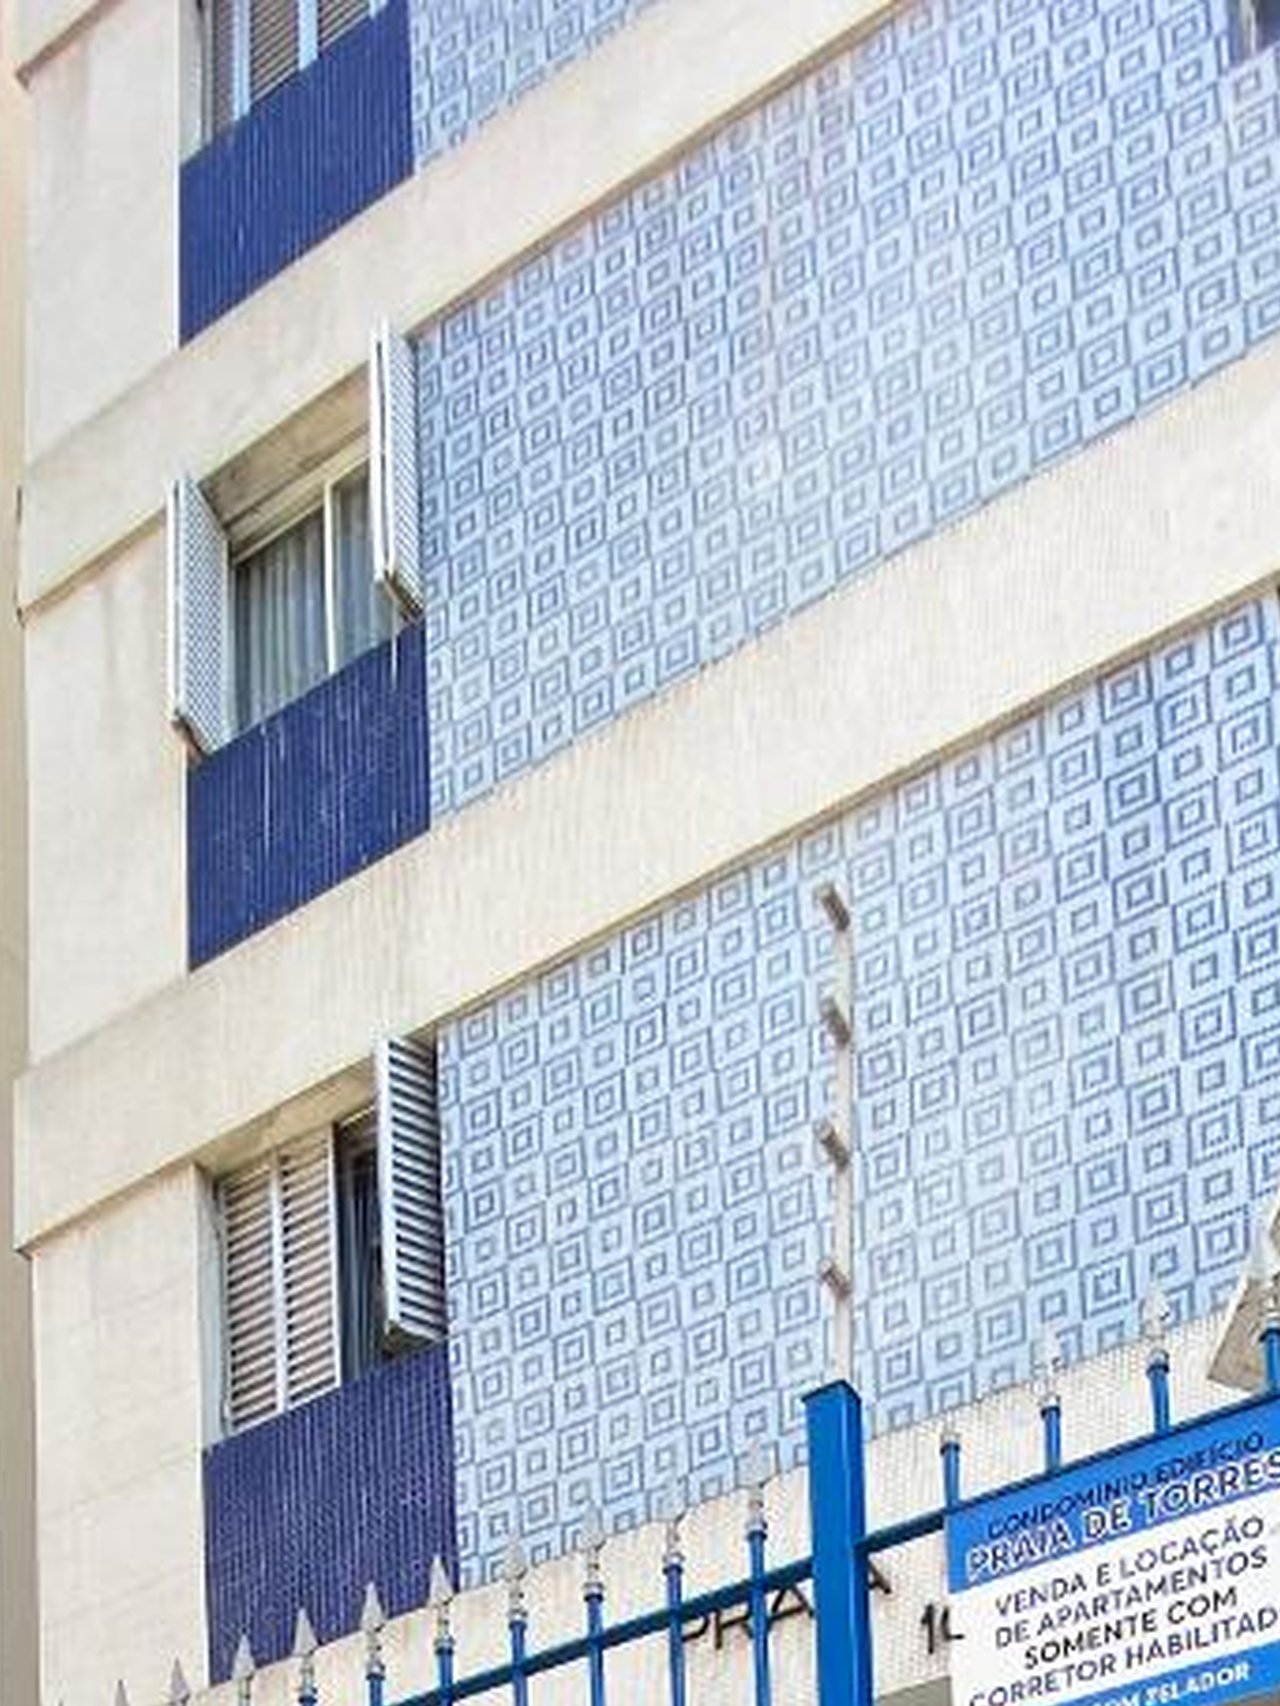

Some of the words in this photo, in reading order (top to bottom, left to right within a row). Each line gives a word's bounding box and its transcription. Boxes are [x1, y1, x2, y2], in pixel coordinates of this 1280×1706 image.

[967, 1518, 1075, 1579] PRAIA
[1083, 1500, 1132, 1541] DE
[995, 1573, 1087, 1617] VENDA
[1096, 1563, 1111, 1587] E
[1120, 1515, 1264, 1579] LOCAÇÃO
[995, 1619, 1031, 1650] DE
[1036, 1545, 1268, 1636] APARTAMENTOS
[1025, 1608, 1158, 1670] SOMENTE
[1168, 1586, 1237, 1625] COM
